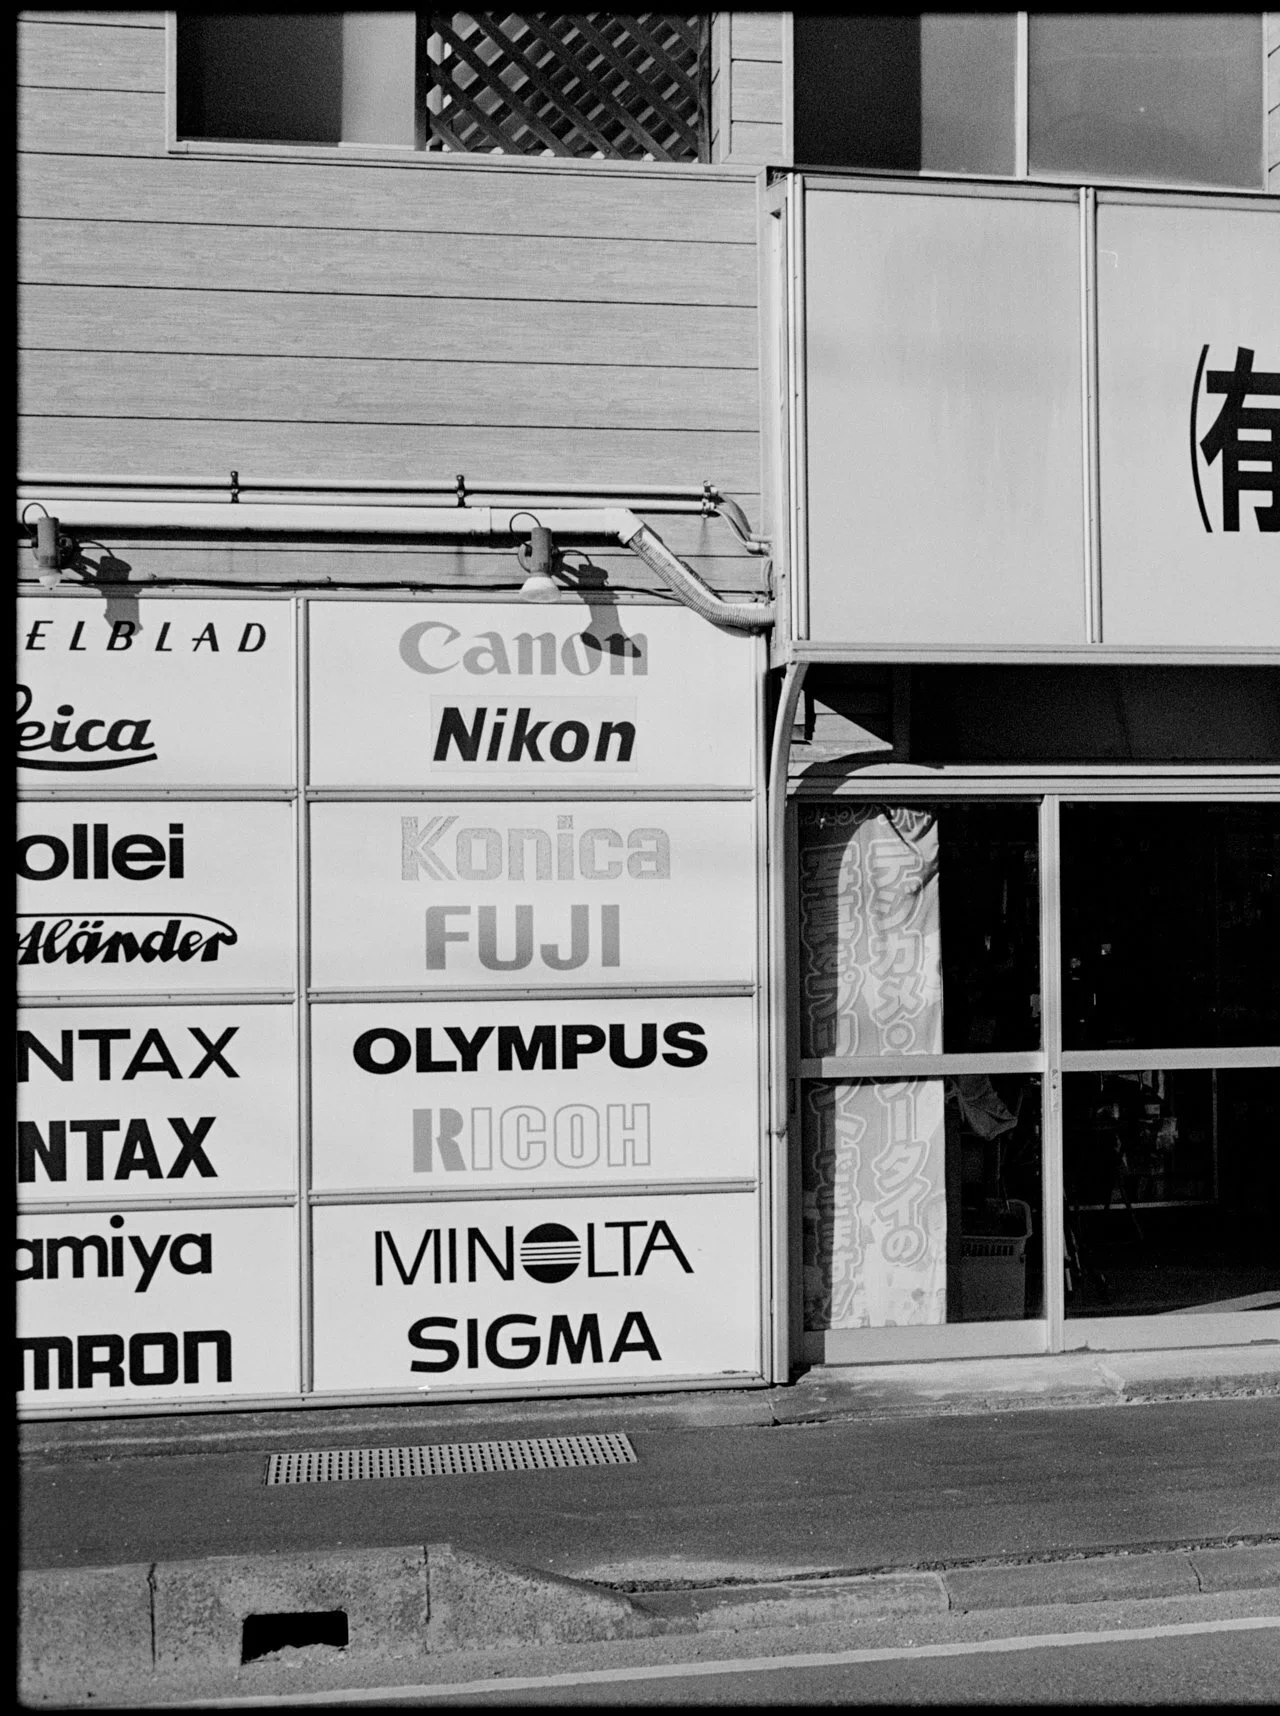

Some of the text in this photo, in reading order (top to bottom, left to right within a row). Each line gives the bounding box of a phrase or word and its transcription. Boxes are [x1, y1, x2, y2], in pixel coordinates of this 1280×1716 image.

[399, 621, 649, 676] Canon
[434, 708, 635, 761] Nikon
[16, 824, 184, 880] ollei
[401, 815, 670, 880] Konica
[425, 905, 620, 971] FUJI
[17, 1027, 239, 1083] NTAX
[354, 1022, 708, 1074] OLYMPUS
[18, 1117, 218, 1183] NTAX
[413, 1103, 652, 1173] RICOH
[16, 1215, 212, 1293] amiya
[375, 1221, 694, 1286] MINOLTA
[408, 1312, 662, 1373] SIGMA
